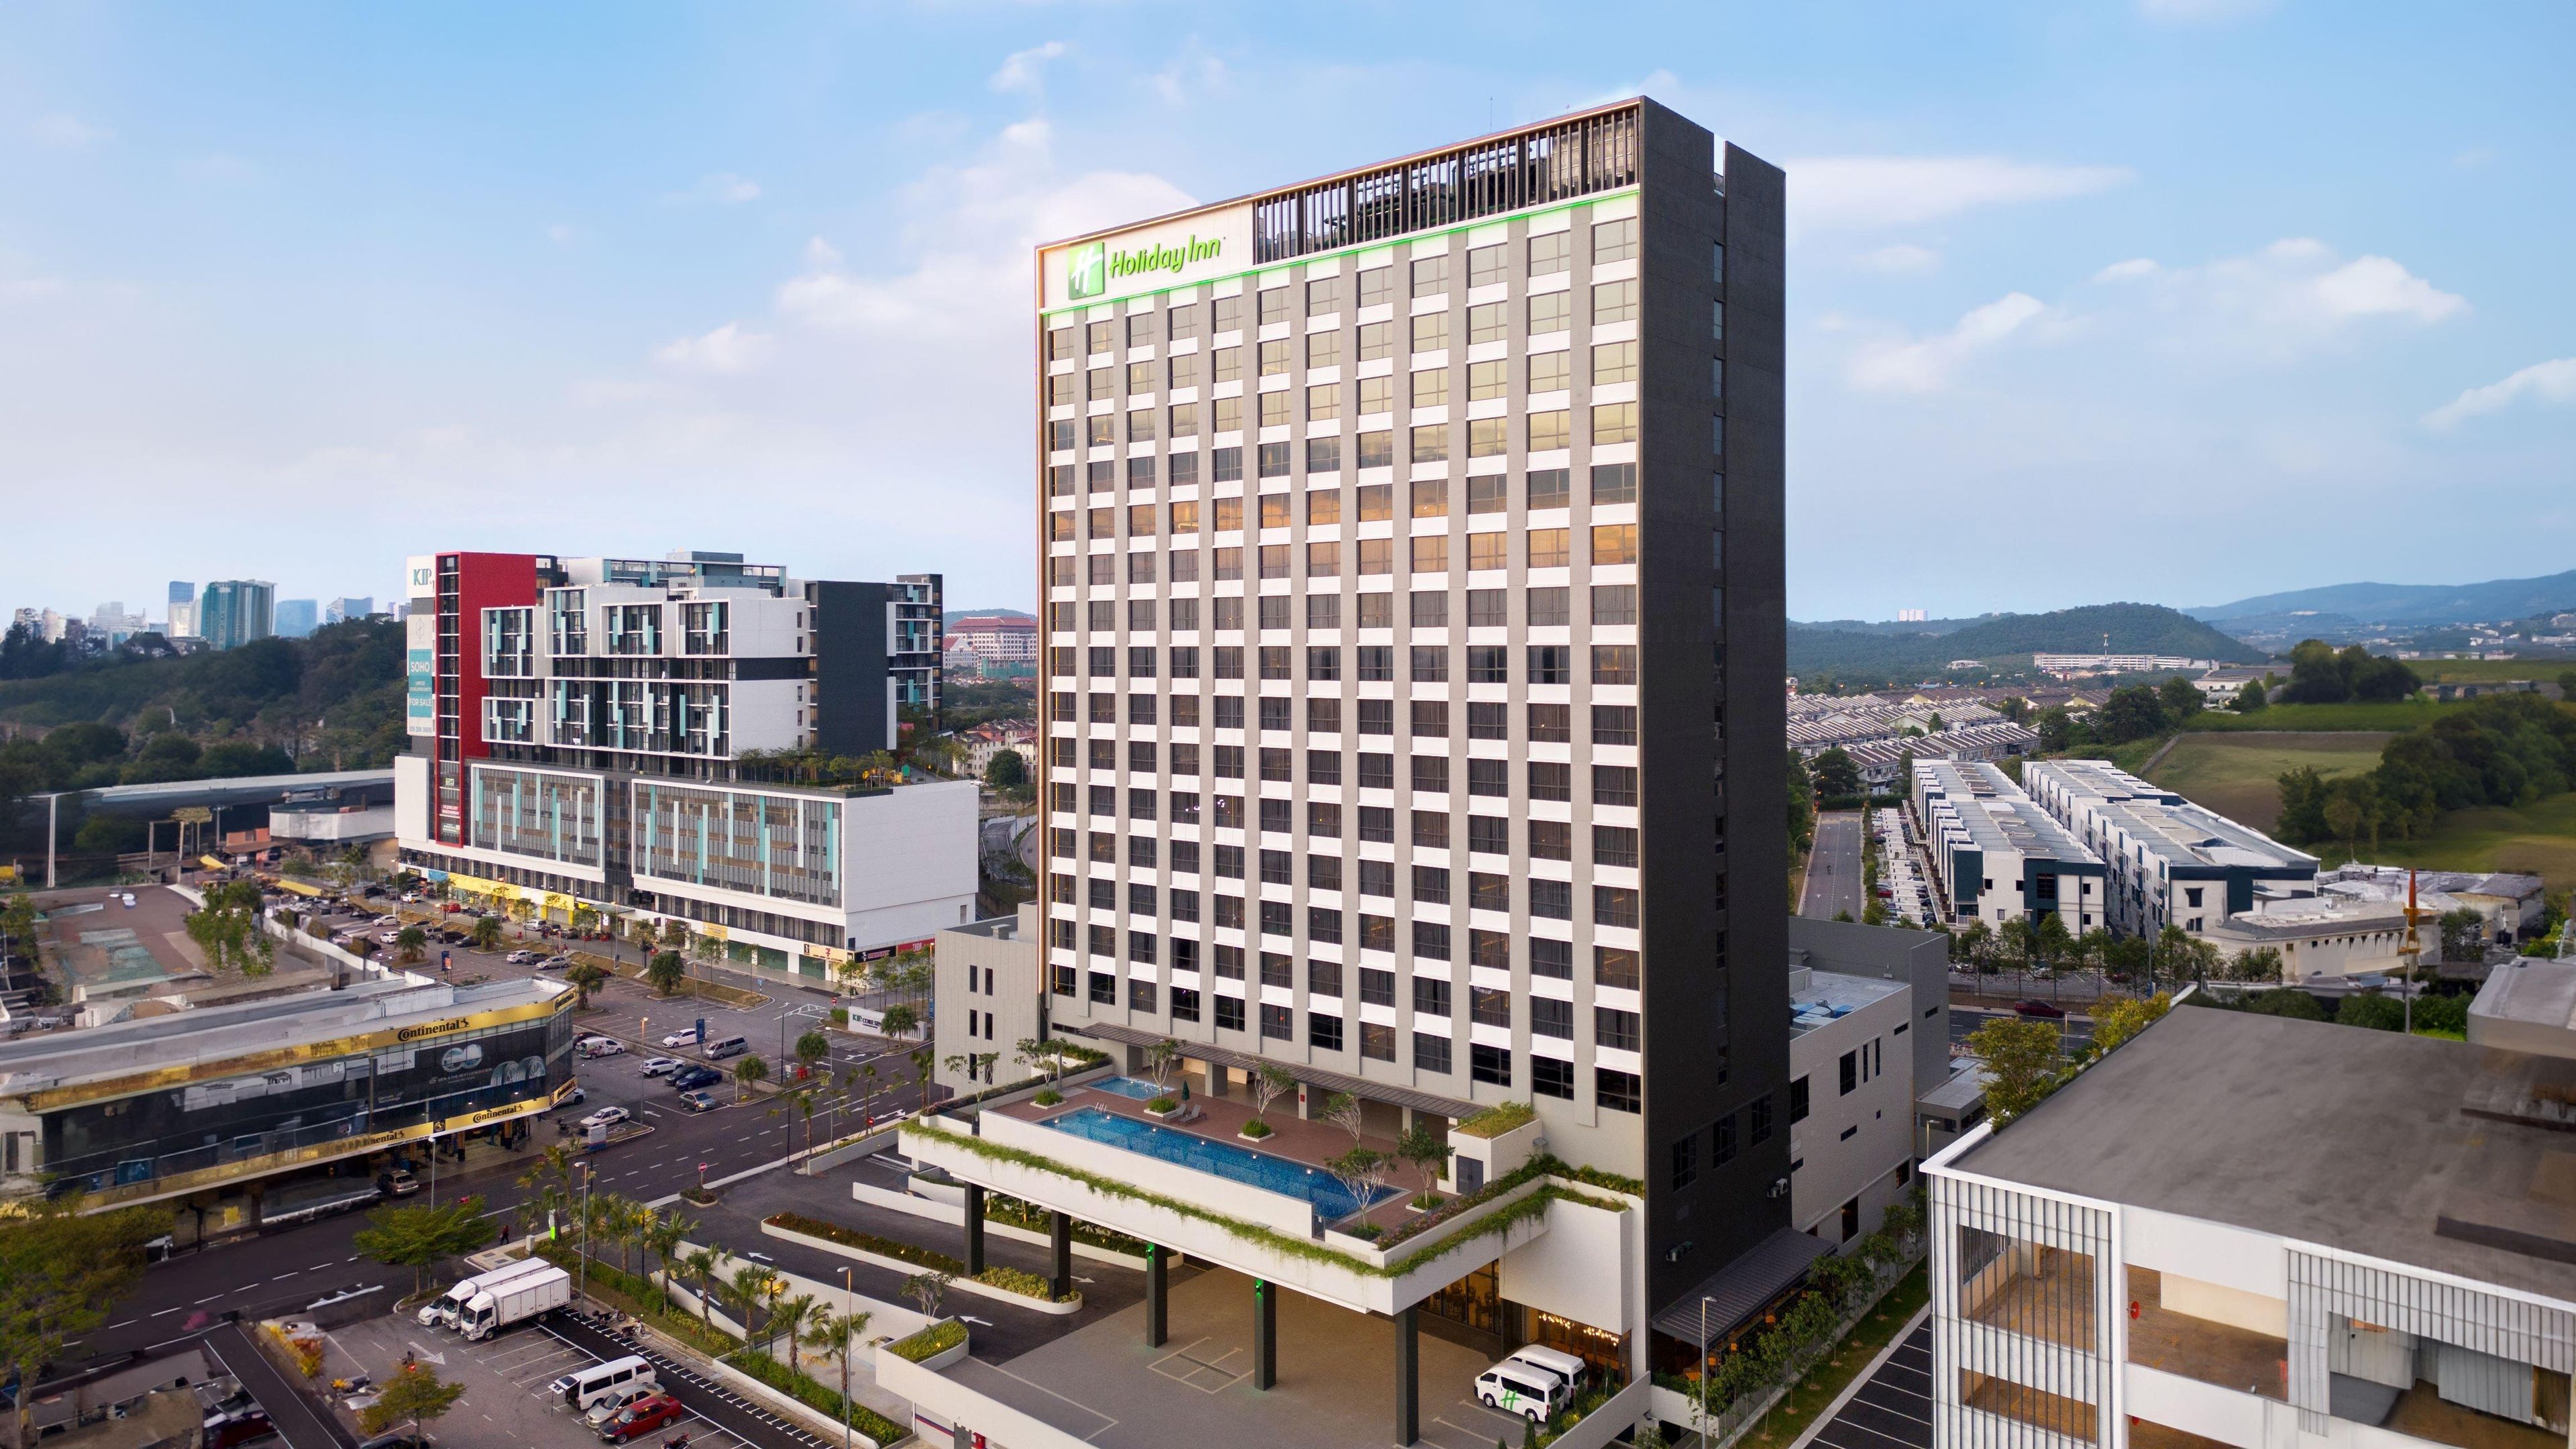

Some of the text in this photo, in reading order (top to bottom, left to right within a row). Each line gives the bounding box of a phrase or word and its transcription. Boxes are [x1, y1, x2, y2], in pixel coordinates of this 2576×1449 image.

[1109, 235, 1220, 278] Holiday Inn
[411, 661, 430, 672] SOHO
[409, 698, 432, 706] FOR SALE
[397, 1019, 459, 1042] Continental
[473, 1106, 517, 1123] Continental
